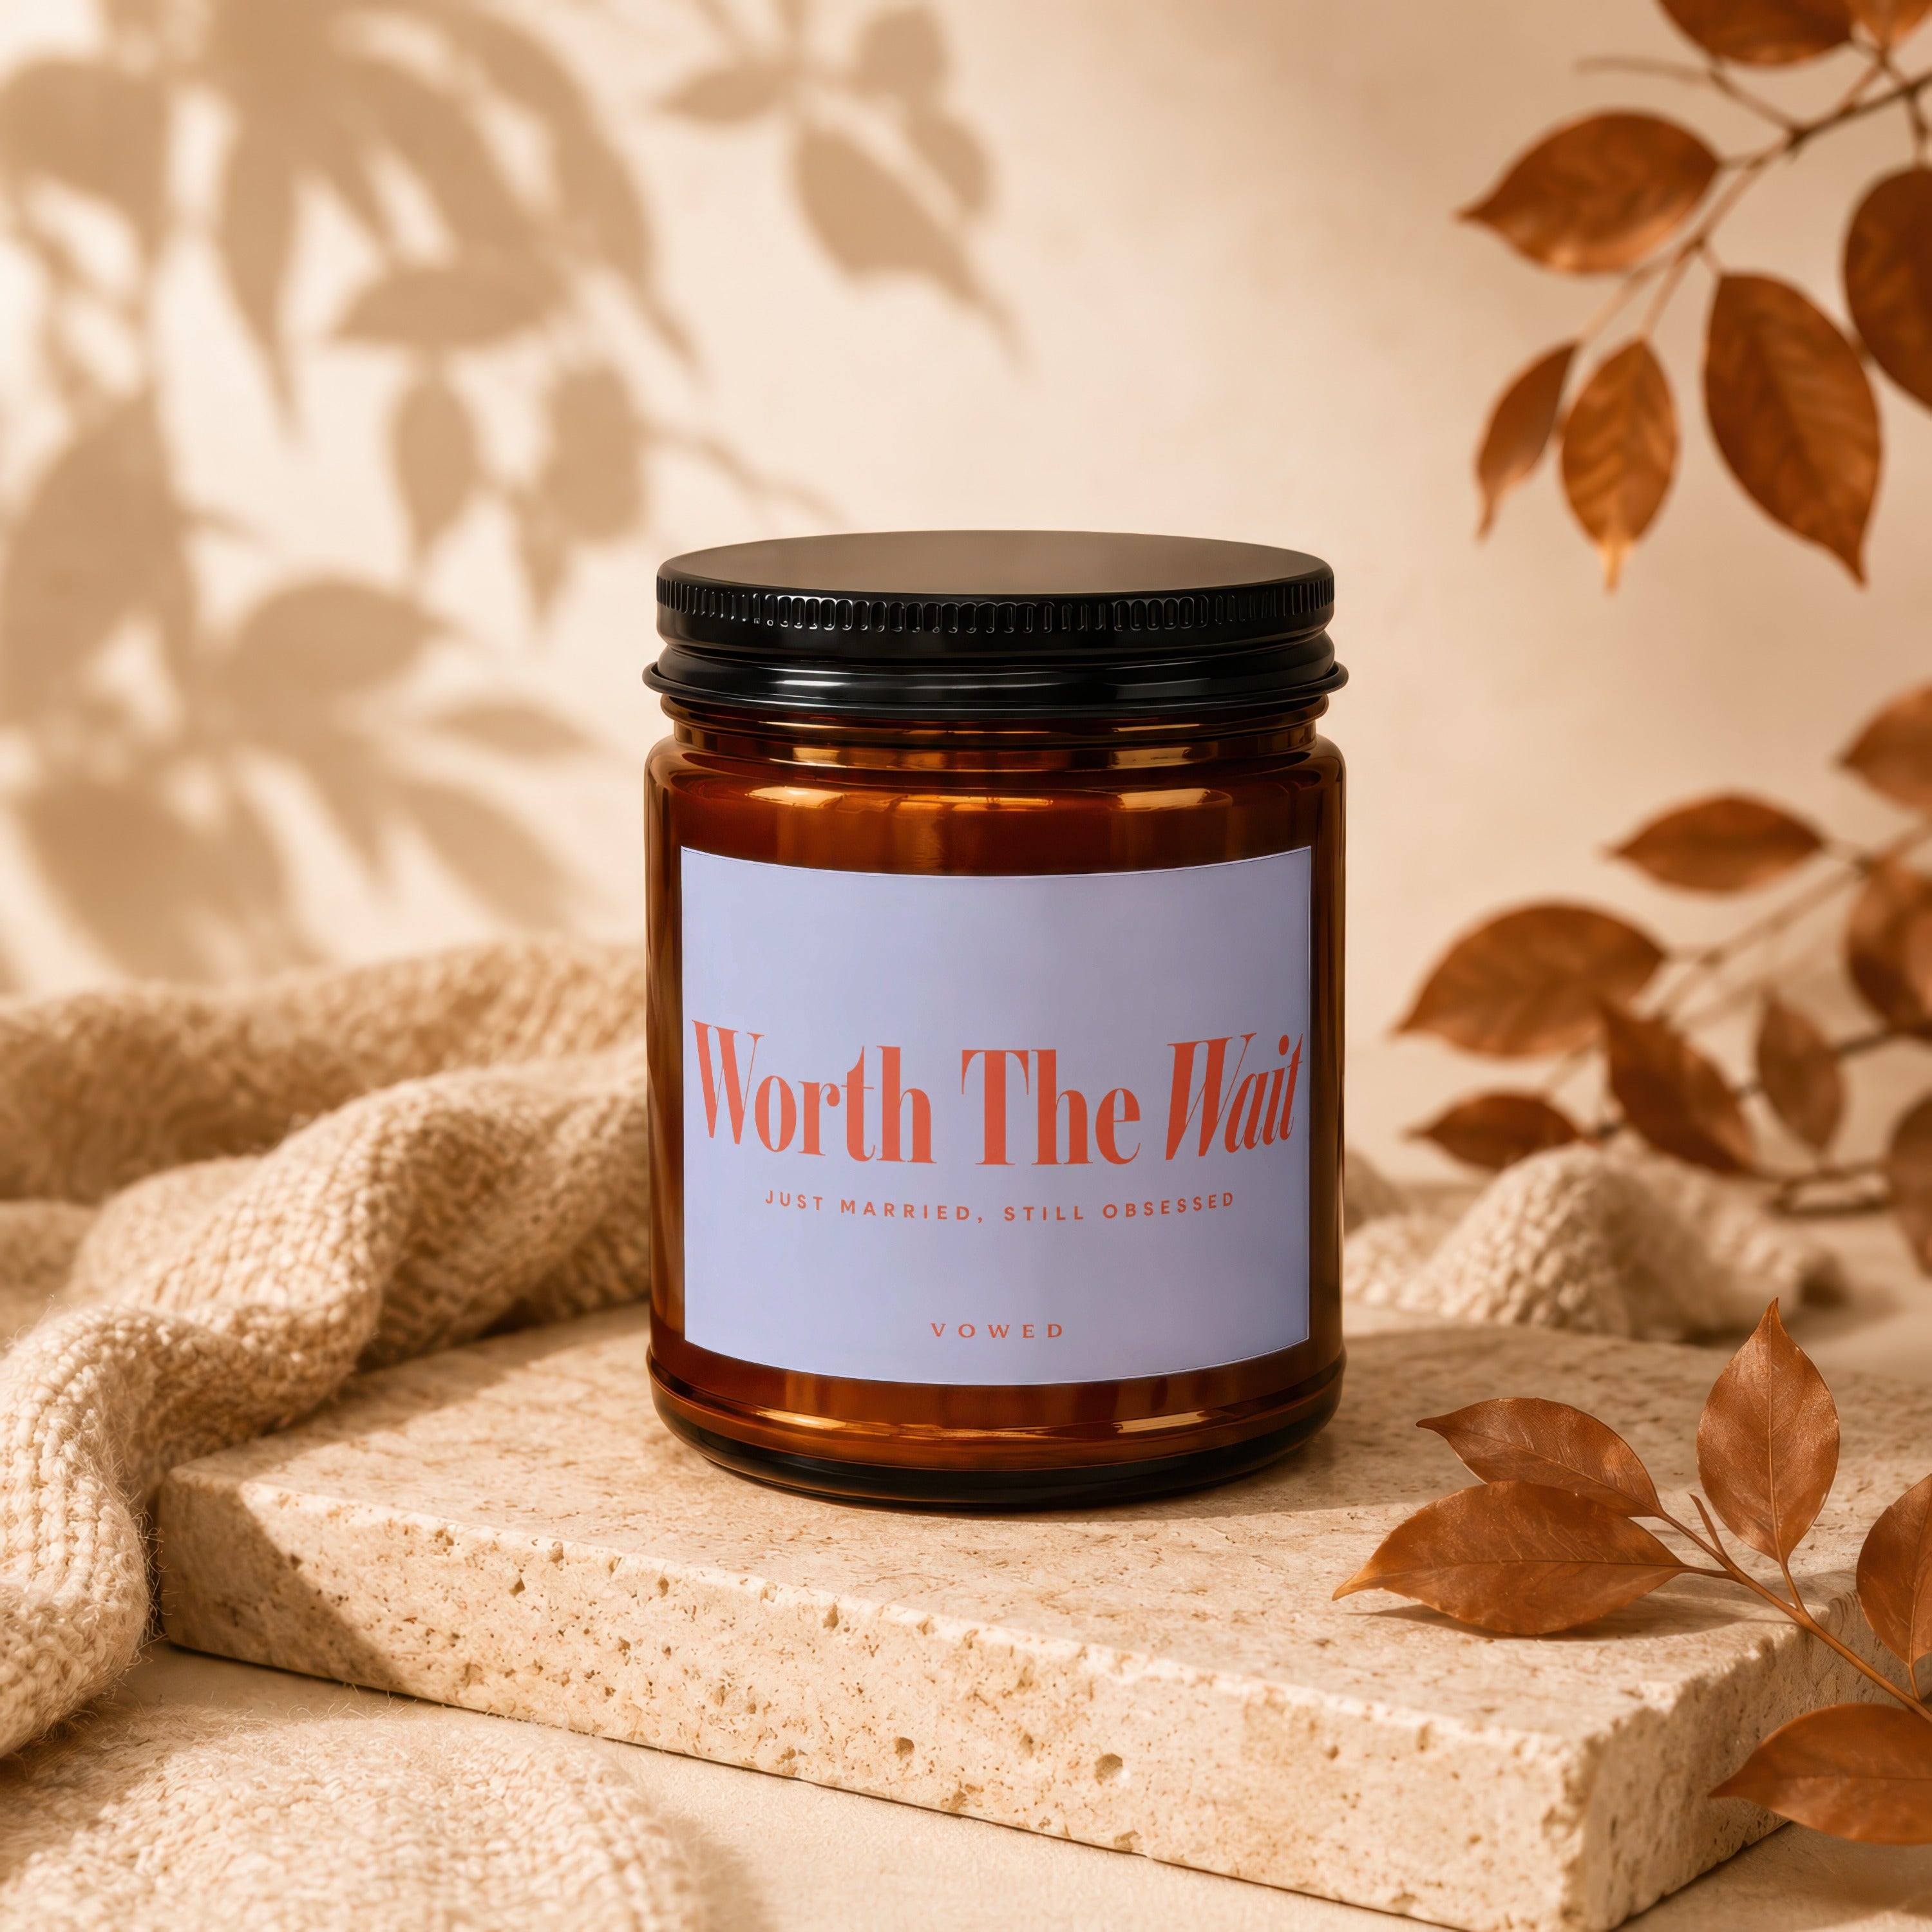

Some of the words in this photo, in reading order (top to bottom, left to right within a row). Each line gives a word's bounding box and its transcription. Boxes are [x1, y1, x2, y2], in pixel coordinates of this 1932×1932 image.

[692, 1019, 937, 1164] Worth
[961, 1048, 1141, 1166] The
[1164, 1032, 1303, 1162] Wait
[764, 1189, 824, 1211] JUST
[840, 1198, 983, 1224] MARRIED,
[1003, 1206, 1084, 1222] STILL
[1102, 1191, 1234, 1220] OBSESSED
[931, 1322, 1063, 1339] VOWED
